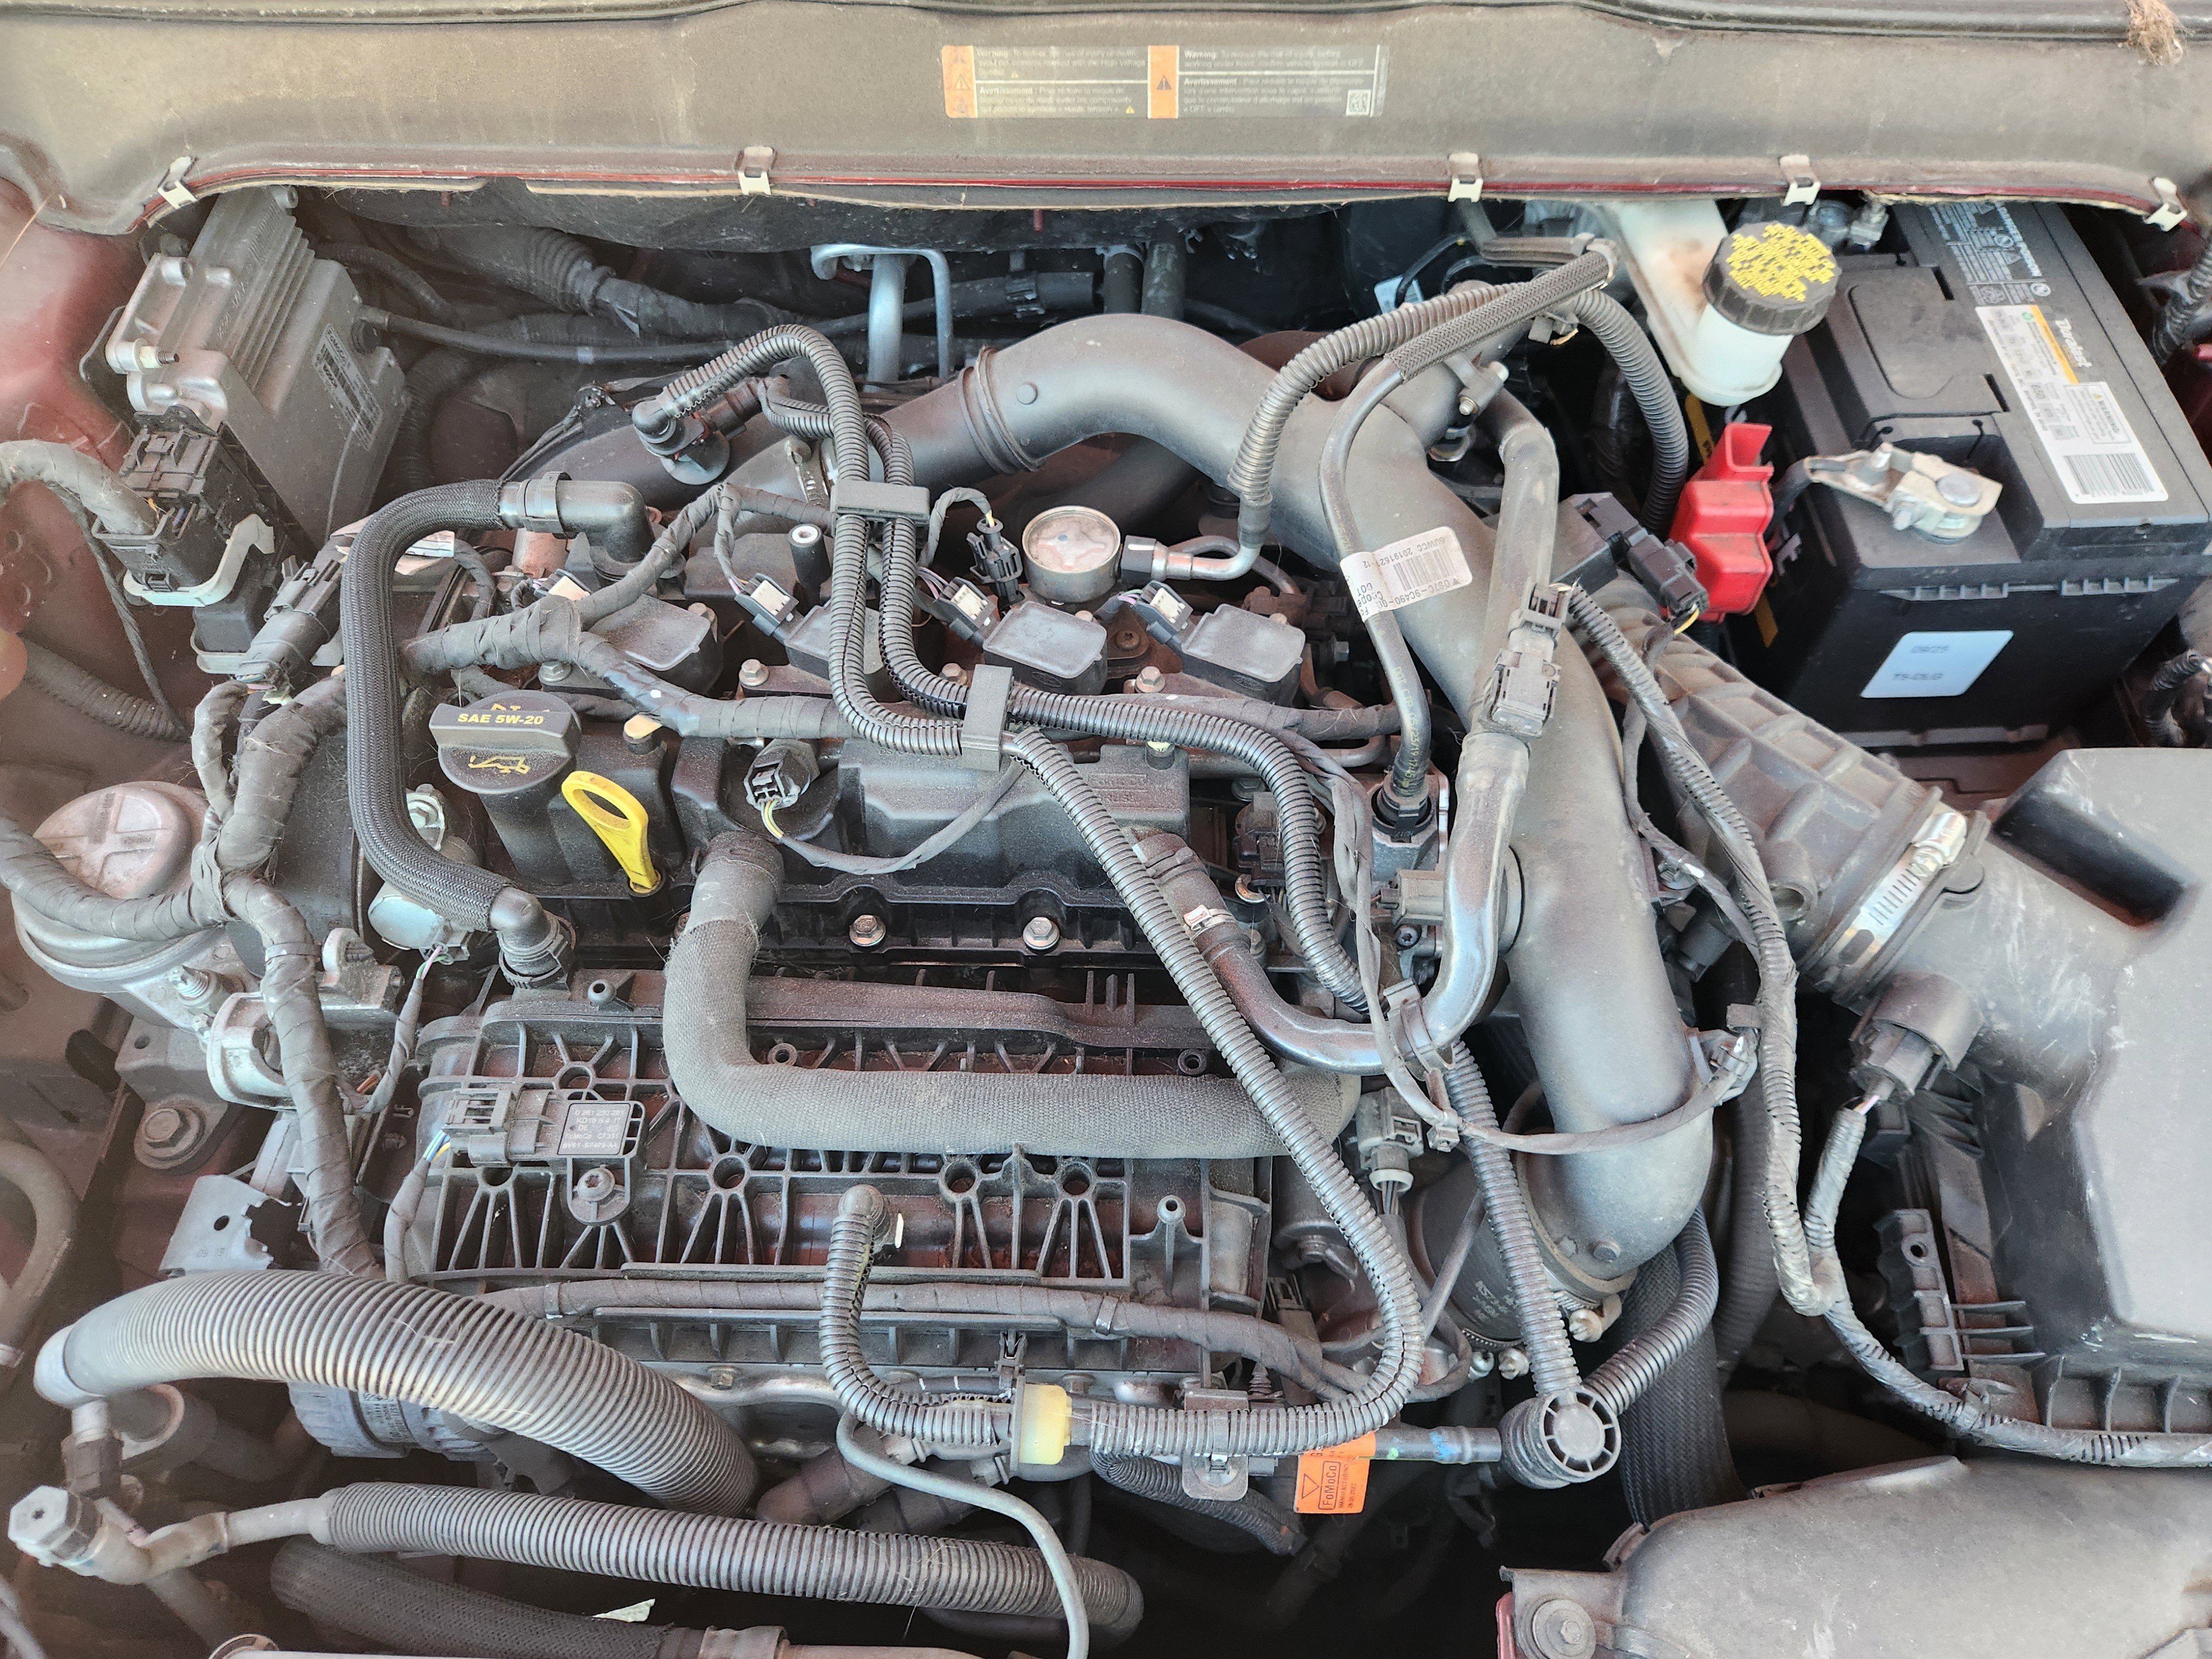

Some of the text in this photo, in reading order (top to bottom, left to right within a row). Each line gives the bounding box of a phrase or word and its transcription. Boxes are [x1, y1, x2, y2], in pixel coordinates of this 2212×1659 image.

[457, 712, 545, 726] SAE 5W-20
[1322, 1464, 1337, 1506] FoMoCo
